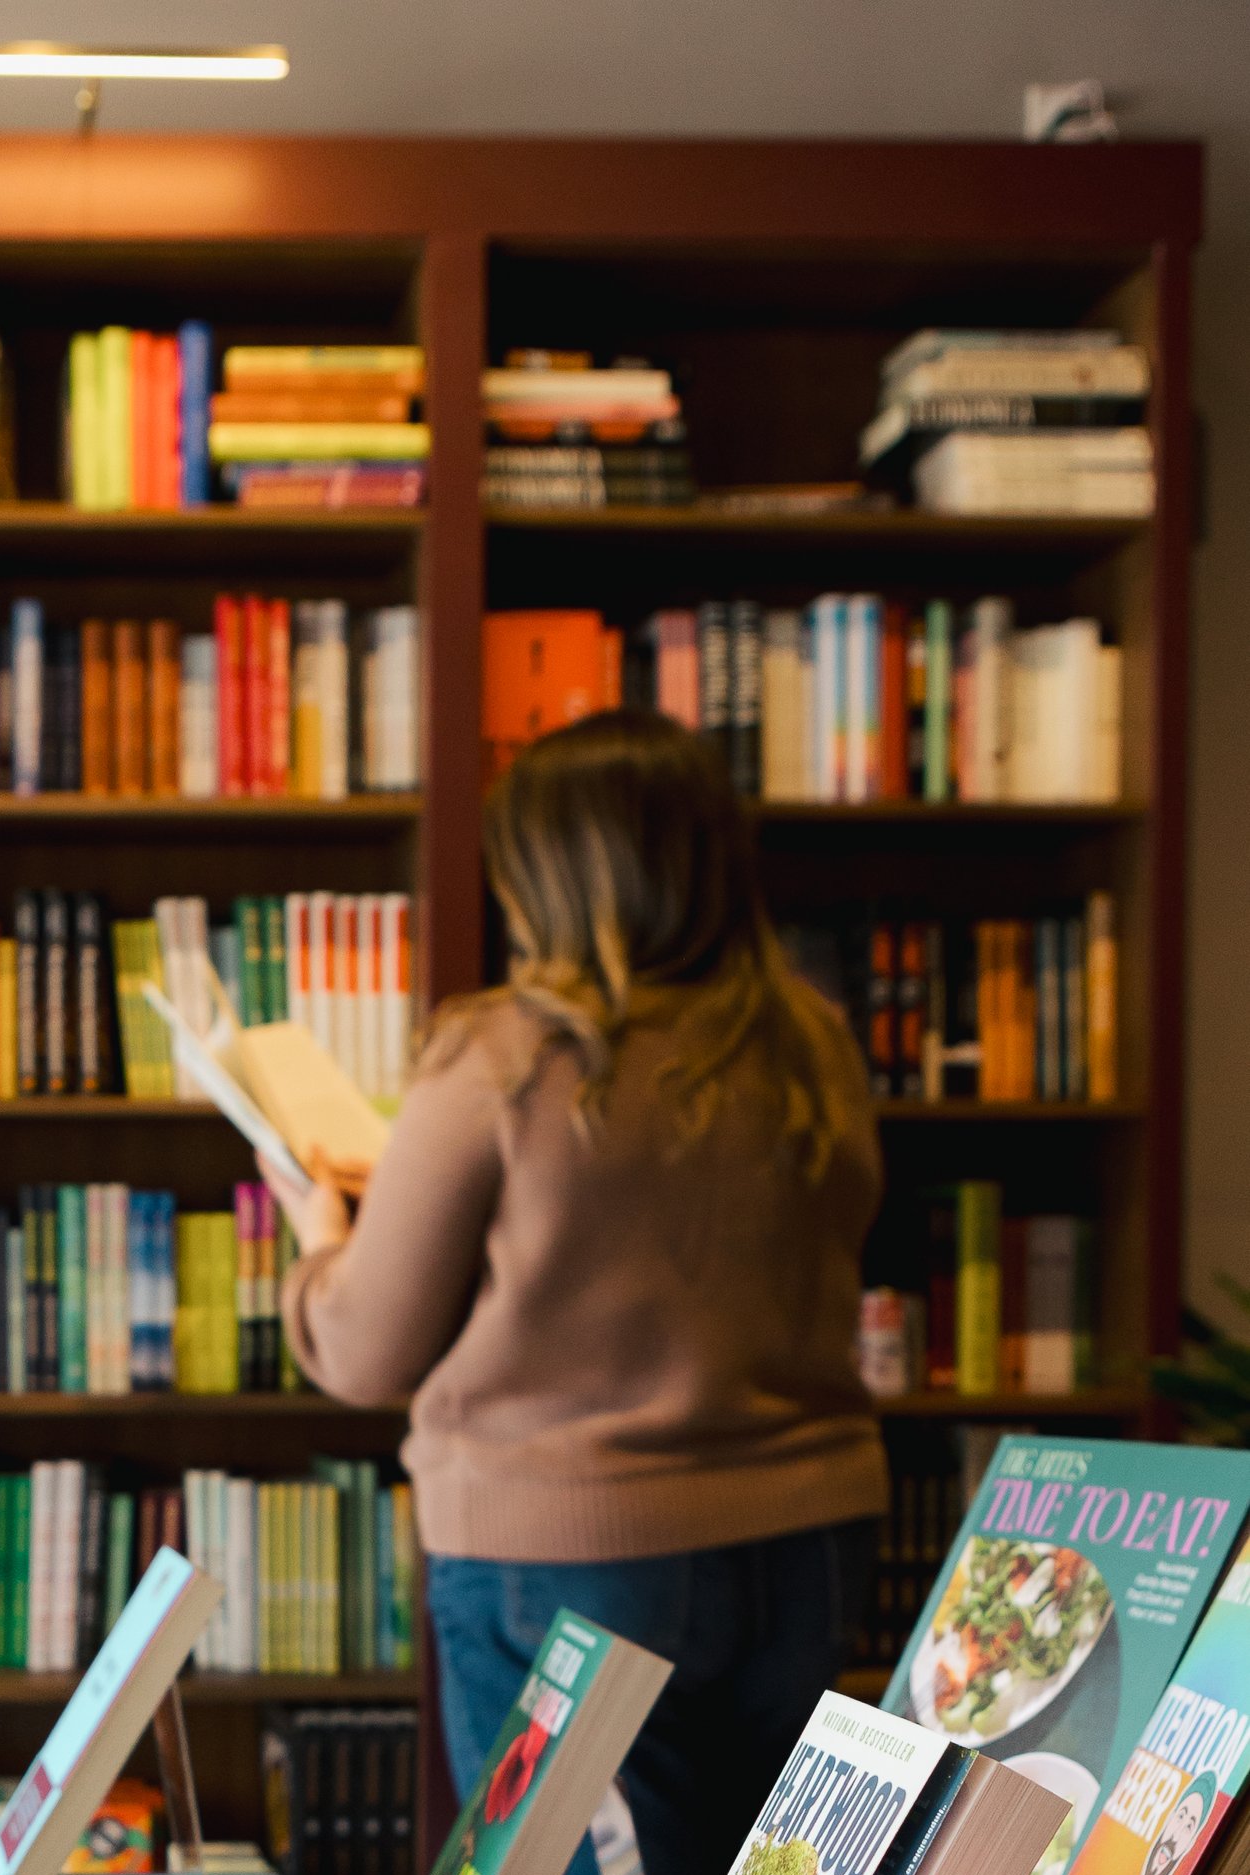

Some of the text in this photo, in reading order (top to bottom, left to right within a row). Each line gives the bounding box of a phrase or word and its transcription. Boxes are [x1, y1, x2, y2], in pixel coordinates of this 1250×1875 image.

[982, 1478, 1231, 1559] TIME TO EAT!
[822, 1710, 917, 1763] NATIONAL BESTSELLER
